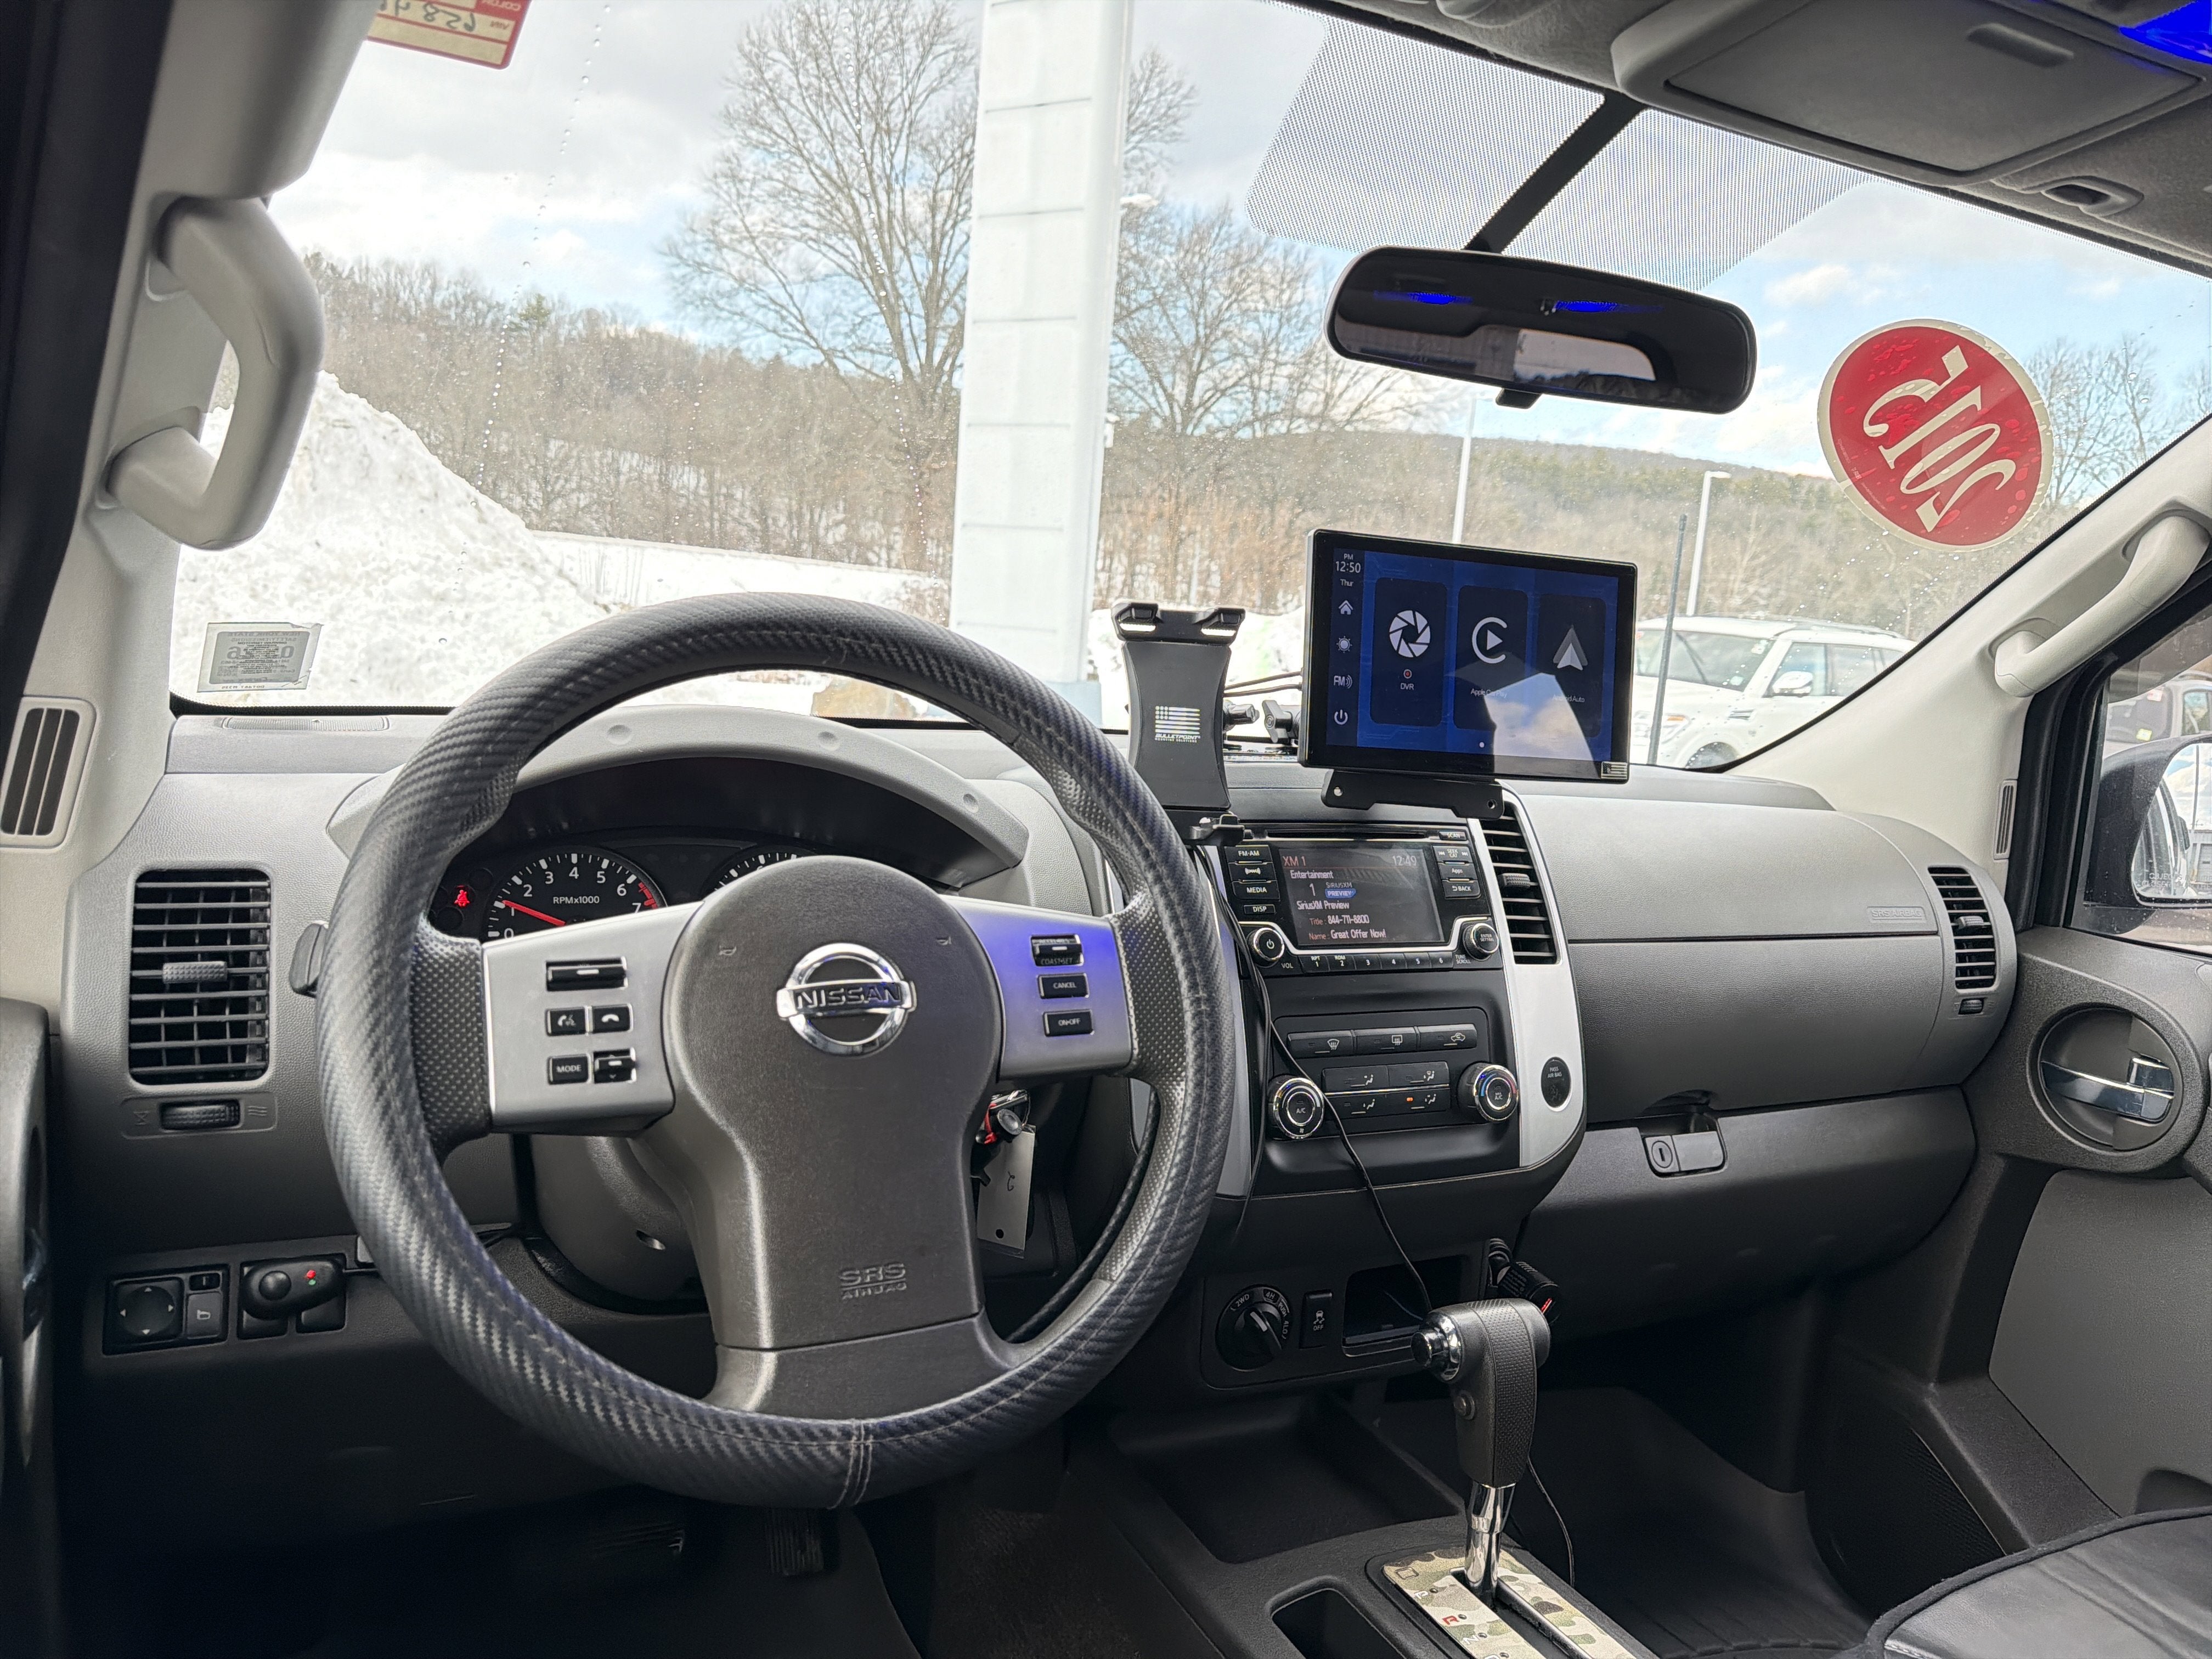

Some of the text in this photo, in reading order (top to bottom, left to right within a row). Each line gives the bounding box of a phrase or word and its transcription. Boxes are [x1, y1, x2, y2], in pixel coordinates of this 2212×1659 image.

[1335, 561, 1361, 573] 12:50
[1340, 578, 1354, 586] Thur
[1334, 675, 1345, 686] FM
[1470, 688, 1486, 697] Apple
[1282, 856, 1307, 866] XM 1
[1392, 855, 1418, 866] 12:49
[545, 871, 554, 884] 3
[568, 867, 579, 879] 4
[596, 871, 606, 883] 5
[1290, 870, 1334, 879] Entertainment
[523, 884, 533, 897] 2
[617, 883, 627, 896] 6
[553, 896, 600, 905] RPMx1000
[1296, 900, 1350, 910] SiriusXM Preview
[632, 902, 642, 913] 7
[1872, 909, 1922, 917] SRS AIRBAG
[1327, 914, 1370, 924] 844-711-8800
[504, 928, 514, 939] 0
[1330, 929, 1349, 940] Great
[1351, 929, 1369, 938] Offer
[1370, 928, 1387, 938] Now!
[796, 987, 901, 1009] NISSAN
[556, 1064, 582, 1073] MODE
[1235, 1294, 1250, 1307] 2WD
[1265, 1291, 1276, 1300] 4H
[1415, 1591, 1429, 1599] P
[1442, 1615, 1459, 1625] R
[1463, 1635, 1480, 1645] N
